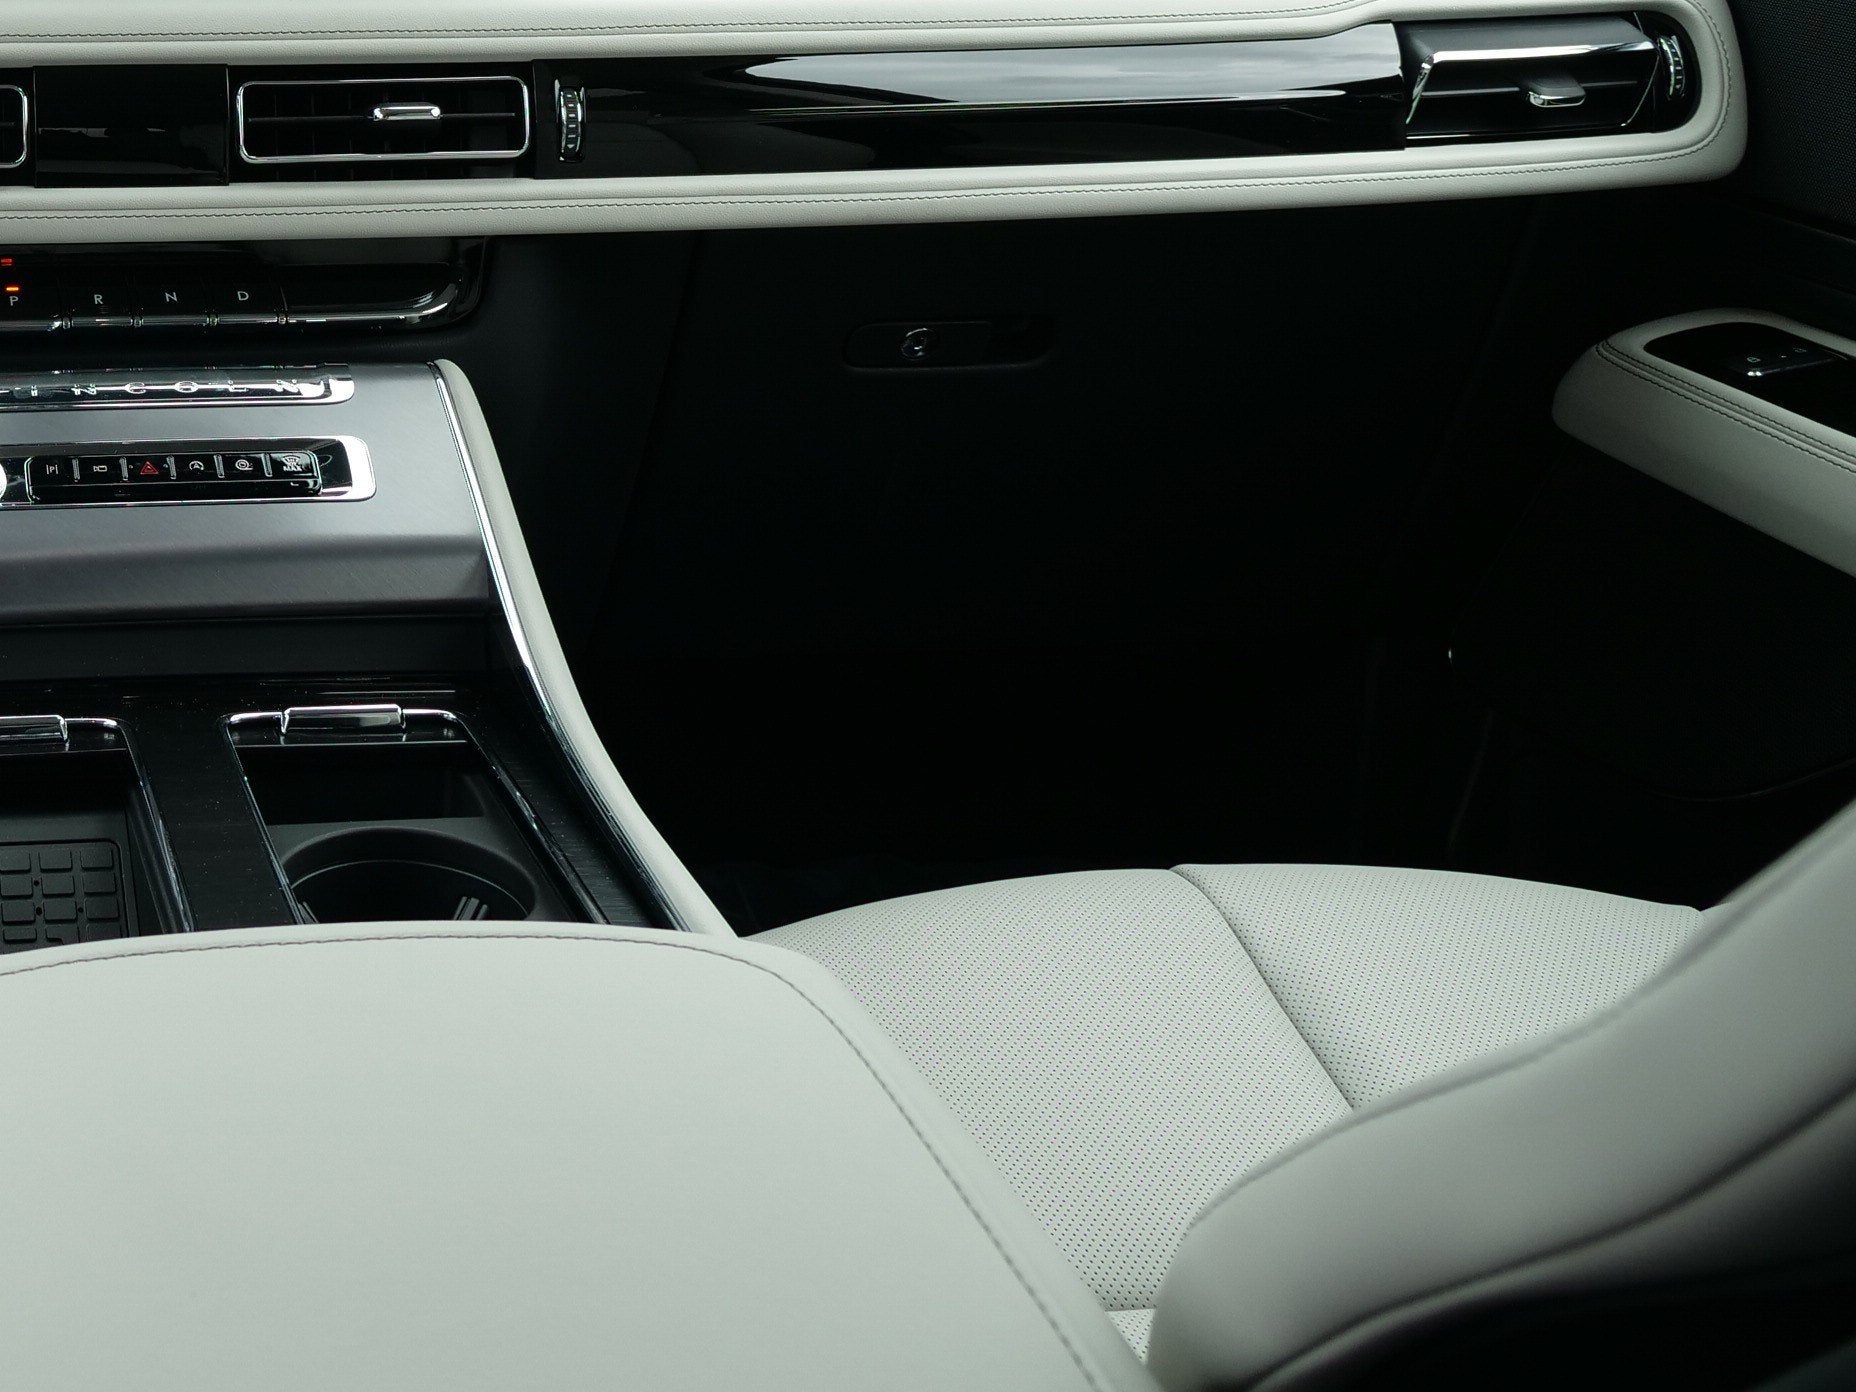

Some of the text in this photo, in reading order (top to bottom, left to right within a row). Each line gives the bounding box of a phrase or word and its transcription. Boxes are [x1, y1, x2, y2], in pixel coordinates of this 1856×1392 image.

[94, 294, 104, 304] R
[164, 292, 178, 302] N
[238, 290, 249, 301] D
[9, 296, 18, 306] P
